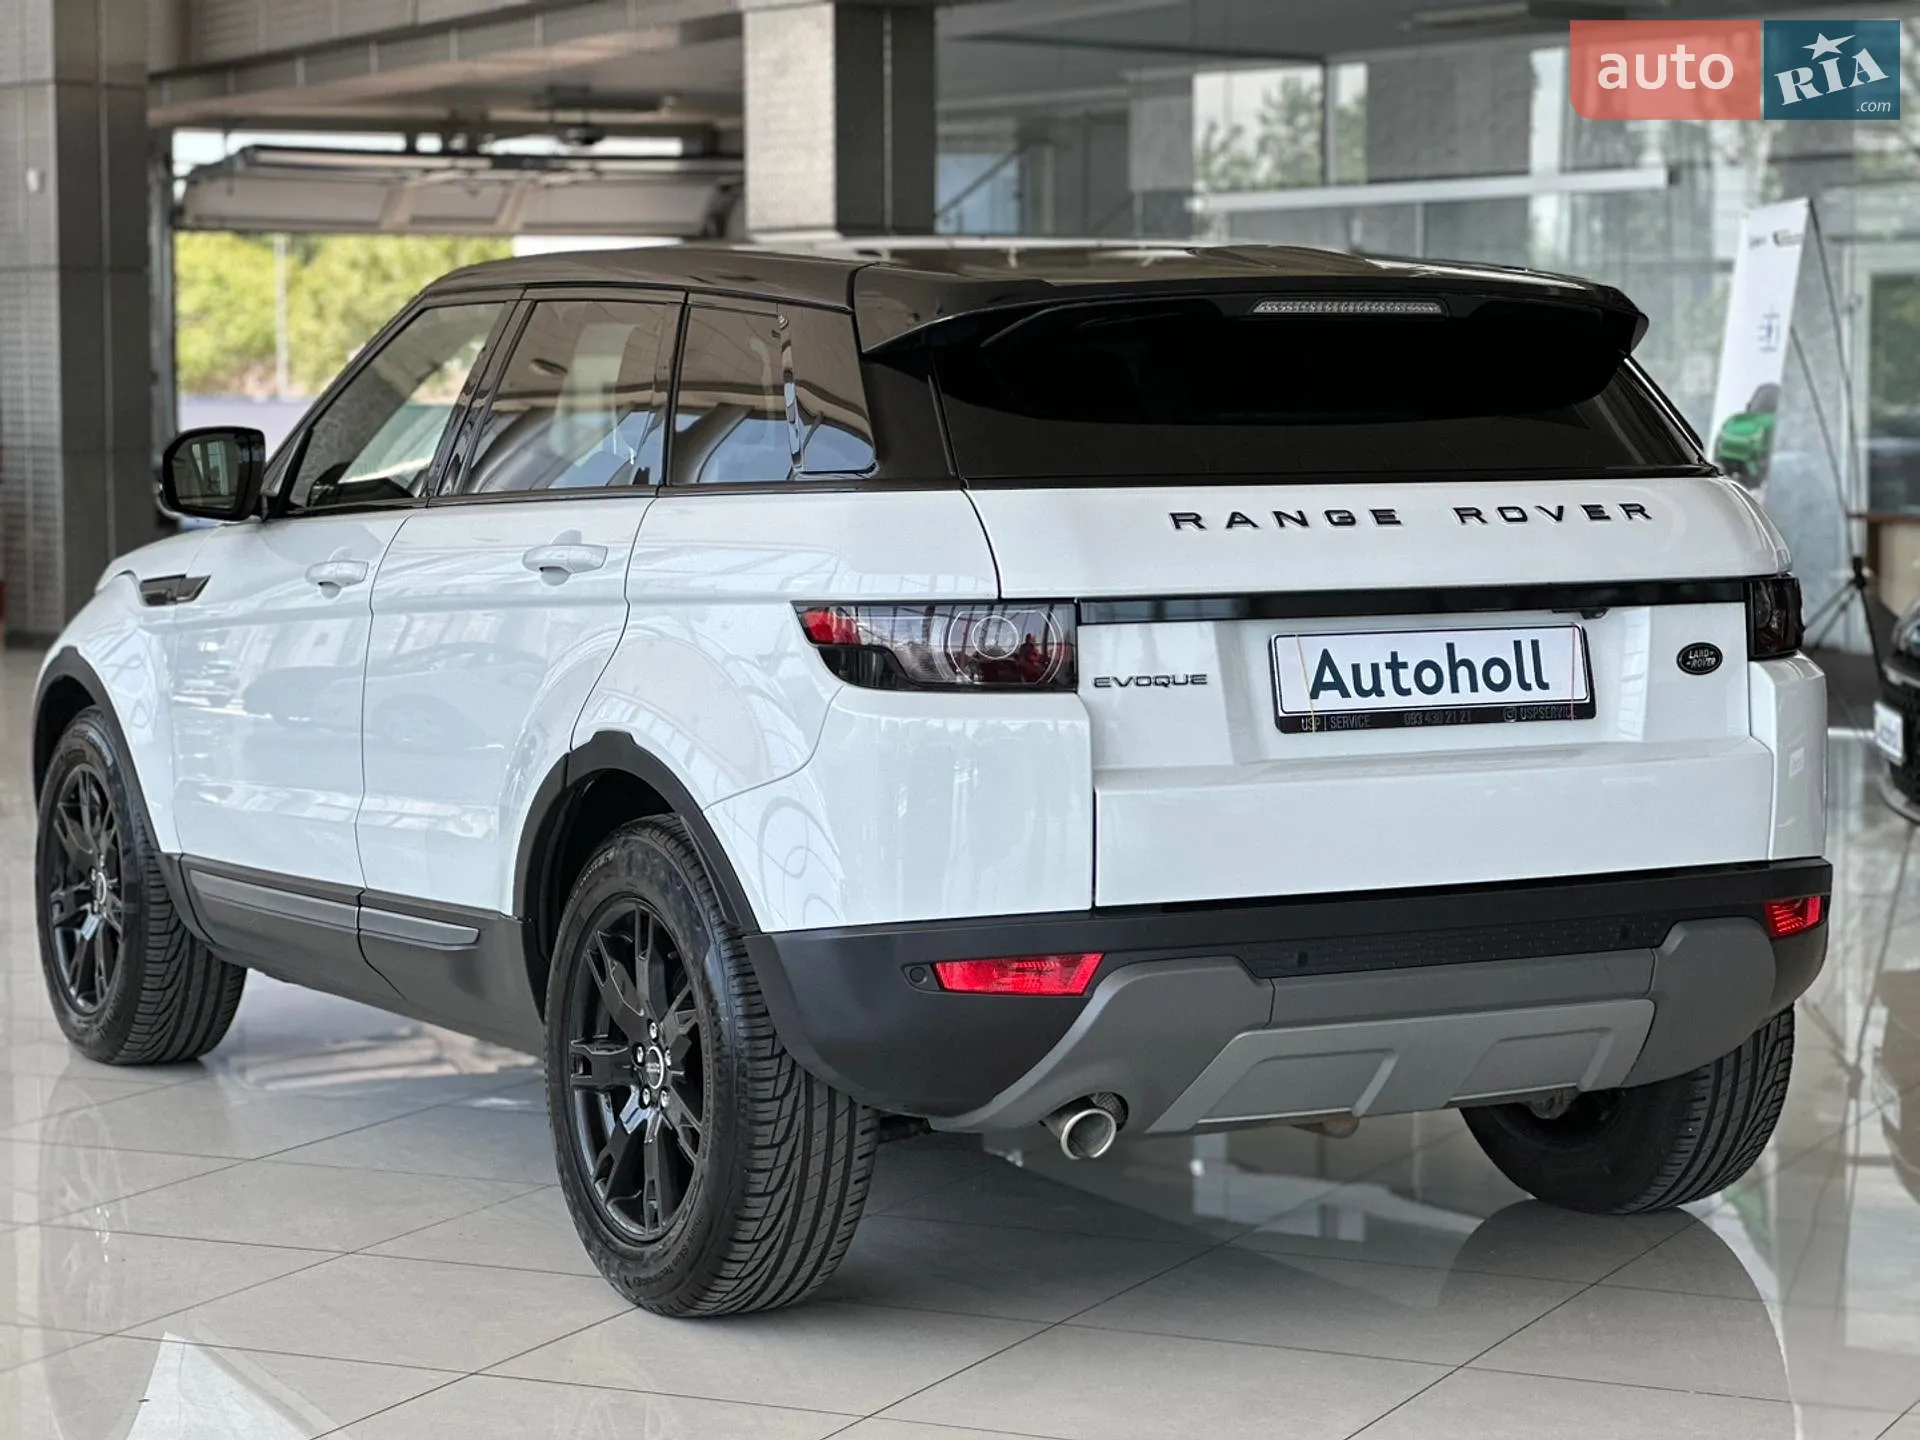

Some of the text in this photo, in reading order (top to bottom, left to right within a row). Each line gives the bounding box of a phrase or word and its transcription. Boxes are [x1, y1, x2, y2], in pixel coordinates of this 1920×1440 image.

[1169, 502, 1653, 530] RANGE ROVER
[1308, 638, 1551, 701] Autoholl
[1093, 673, 1208, 689] EVOQUE
[1330, 714, 1370, 729] SERVICE
